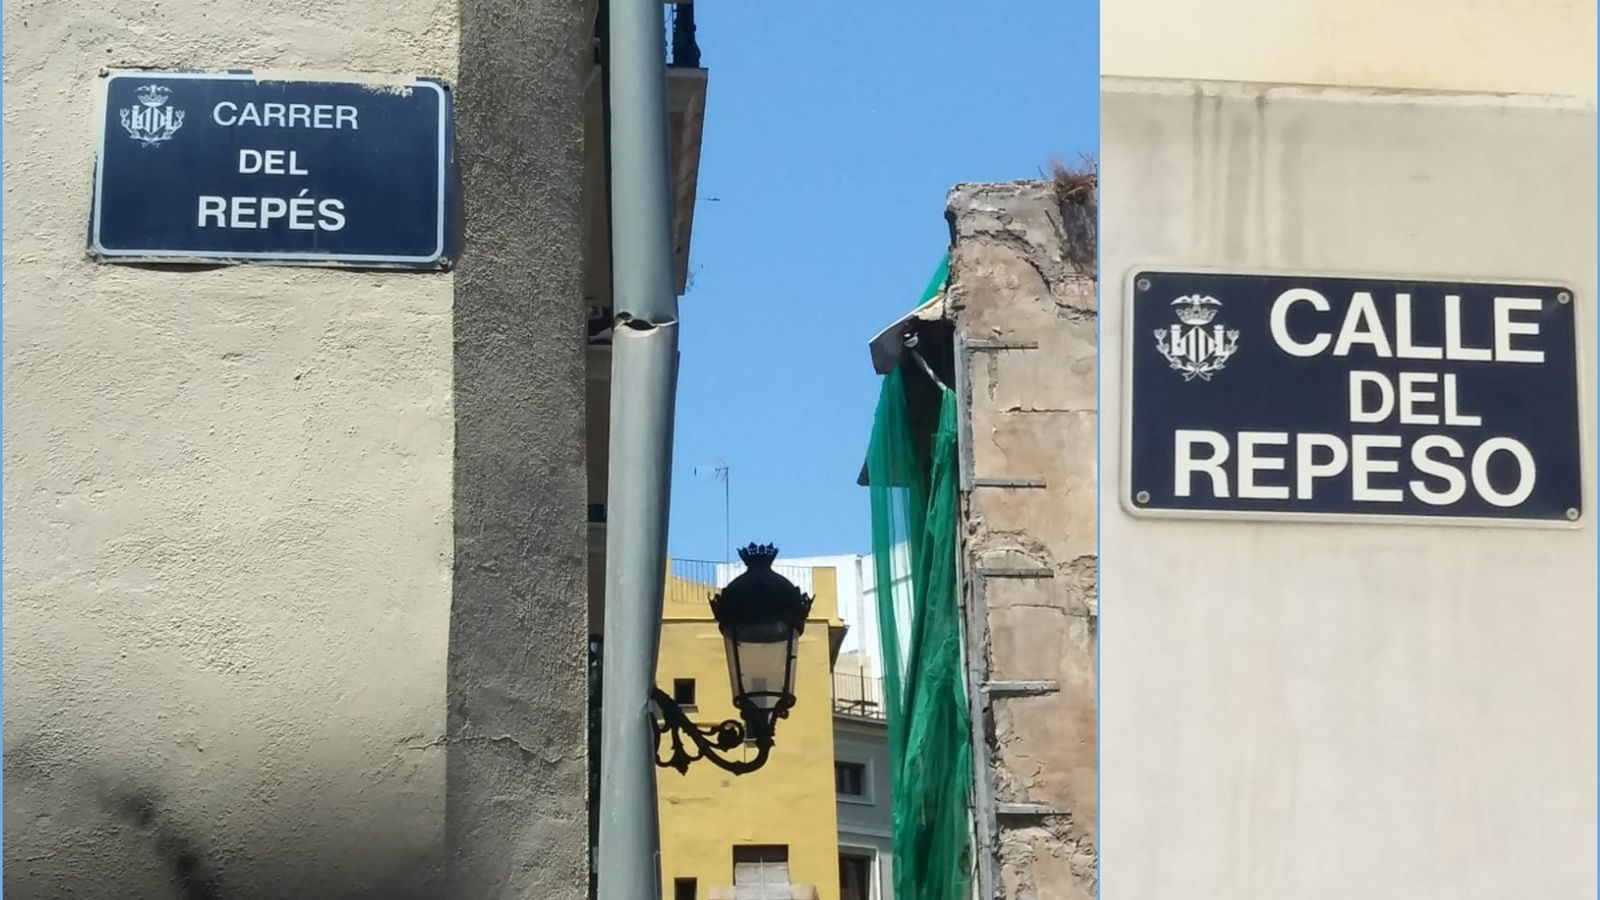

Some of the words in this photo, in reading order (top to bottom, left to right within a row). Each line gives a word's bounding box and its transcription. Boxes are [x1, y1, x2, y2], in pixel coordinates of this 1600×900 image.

[213, 101, 358, 129] CARRER
[239, 149, 309, 176] DEL
[197, 188, 346, 232] REPÉS
[1270, 288, 1545, 363] CALLE
[1349, 370, 1482, 426] DEL
[1174, 429, 1536, 507] REPESO
